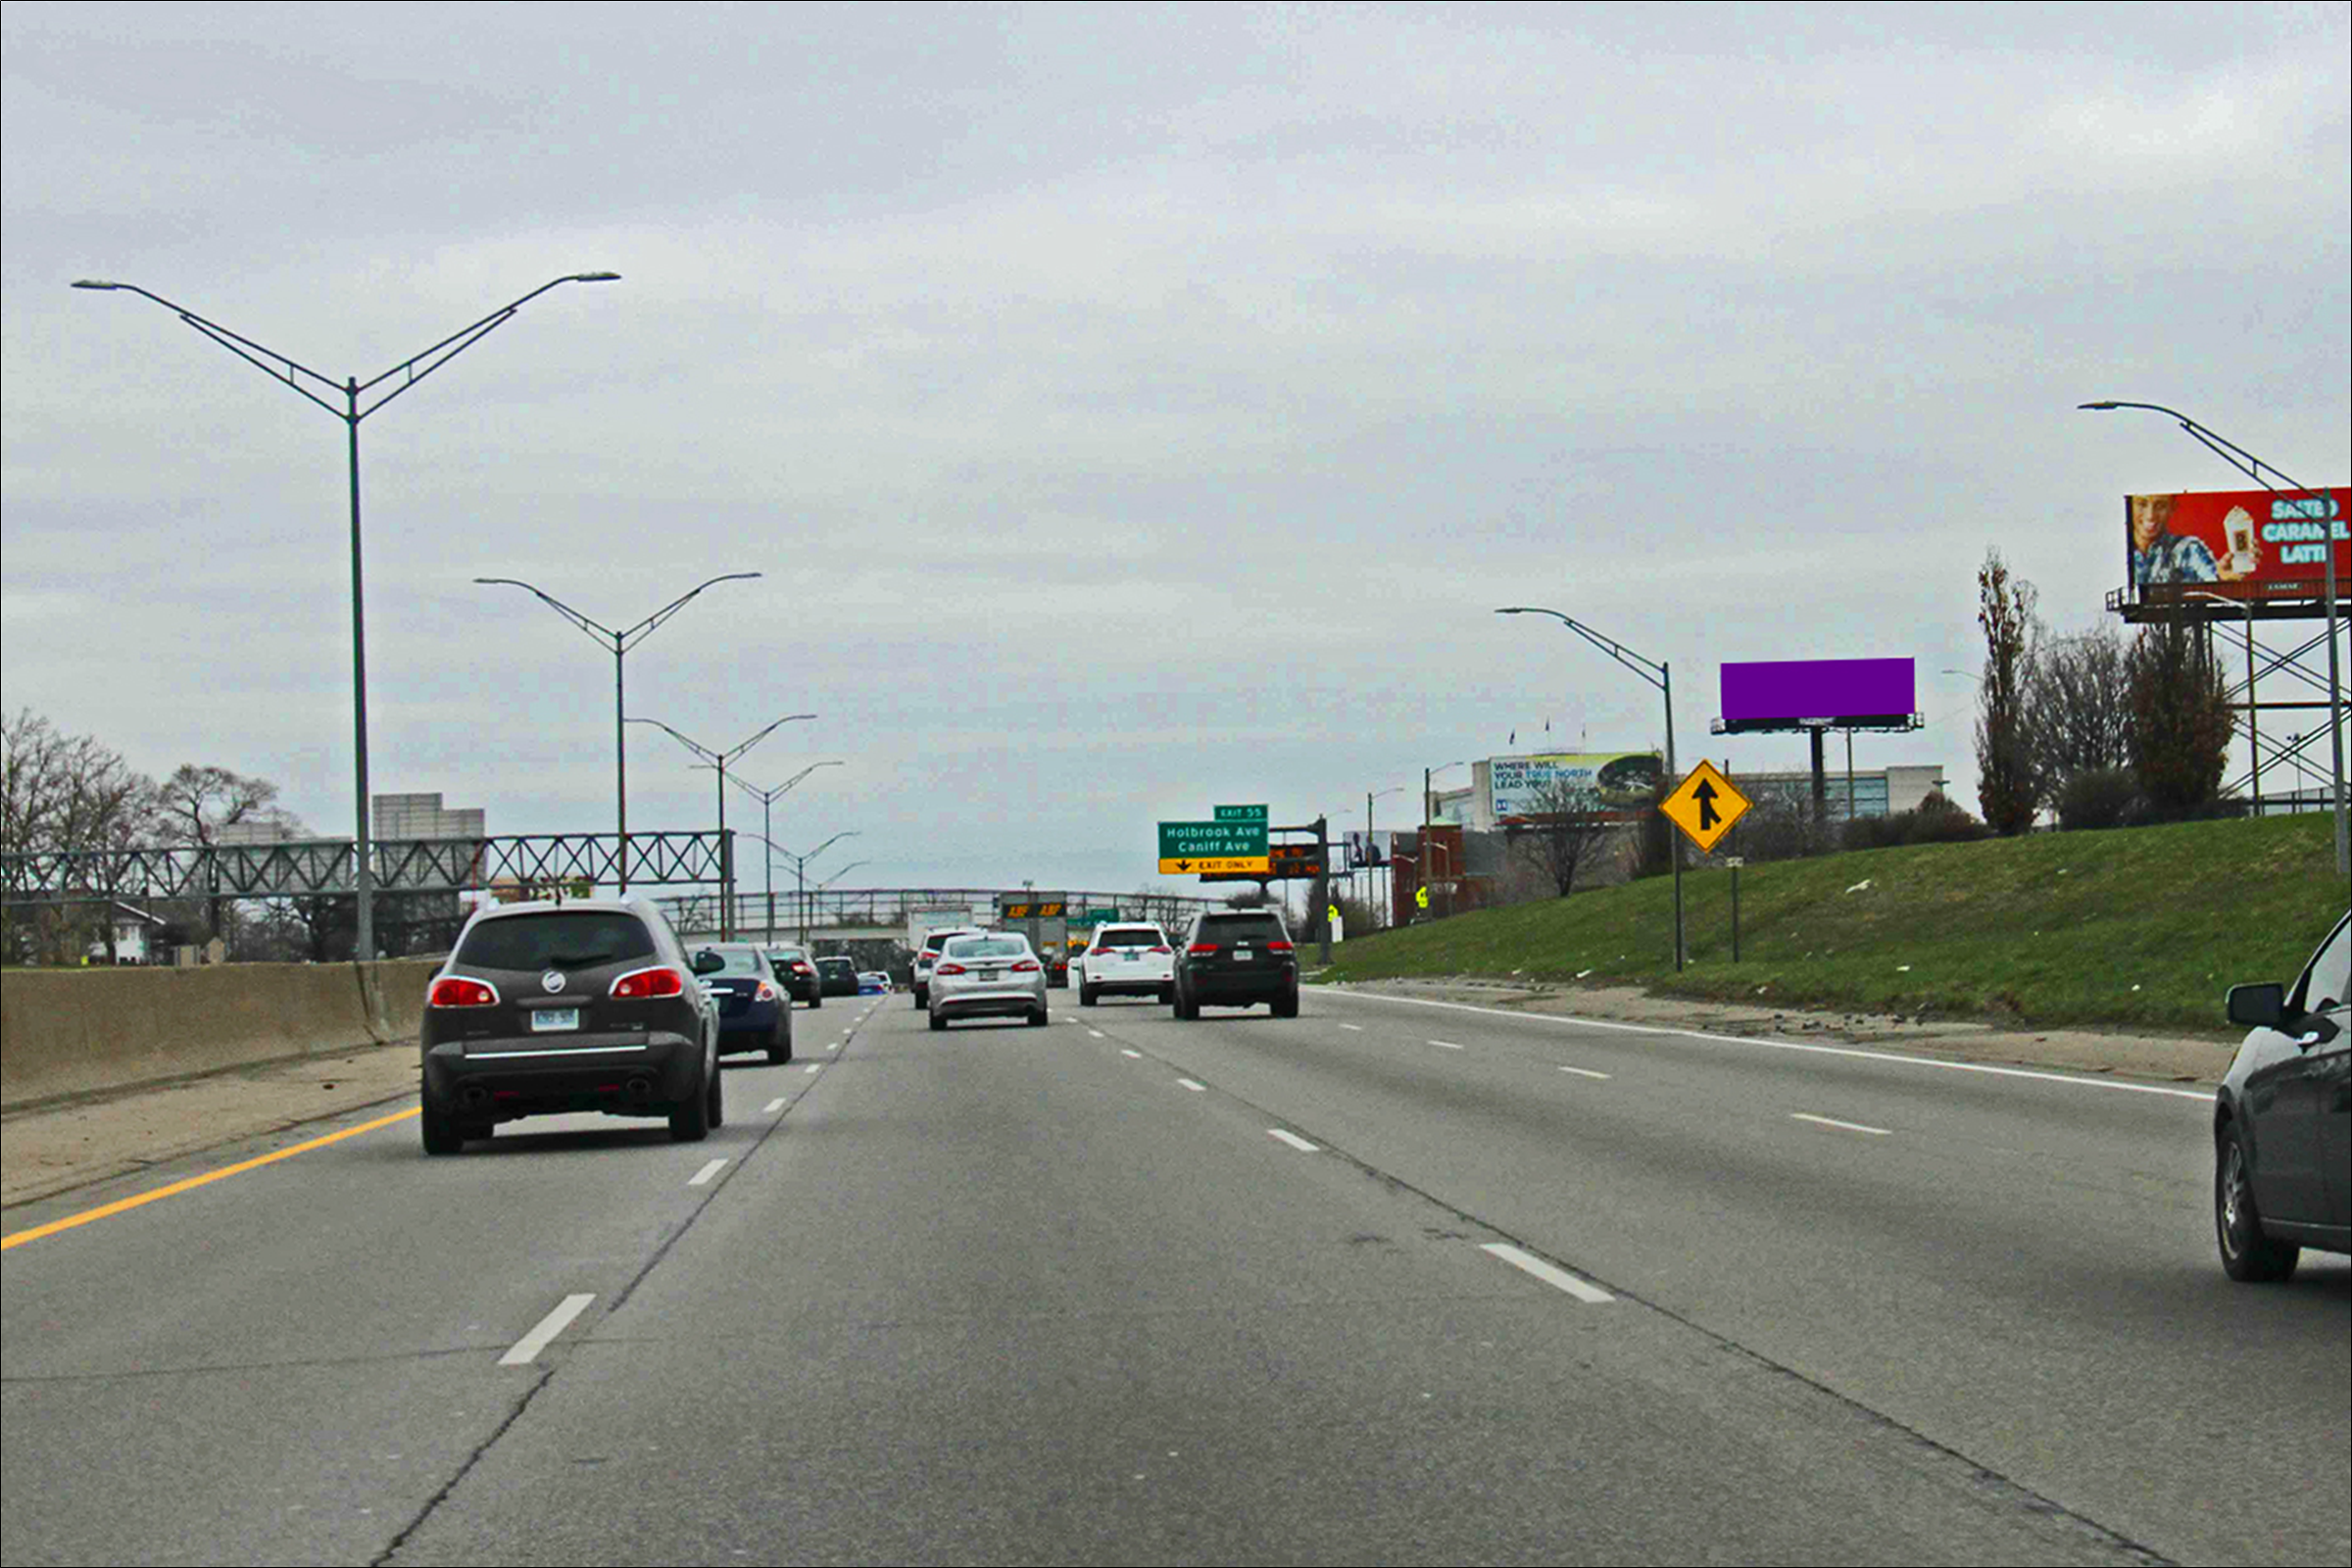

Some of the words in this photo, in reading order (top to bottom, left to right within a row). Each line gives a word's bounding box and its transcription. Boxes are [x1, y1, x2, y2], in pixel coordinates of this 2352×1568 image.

[2271, 499, 2339, 519] SALTED
[1494, 761, 1530, 771] WHERE
[1494, 770, 1523, 780] YOUR
[1494, 780, 1523, 790] LEAD
[1220, 808, 1243, 817] EXIT
[1247, 808, 1262, 817] 55
[1166, 826, 1231, 838] Holbrook
[1235, 826, 1260, 837] Ave
[1178, 841, 1221, 853] Caniff
[1224, 841, 1250, 852] Ave
[1199, 860, 1222, 870] EXIT
[1225, 859, 1254, 869] ONLY
